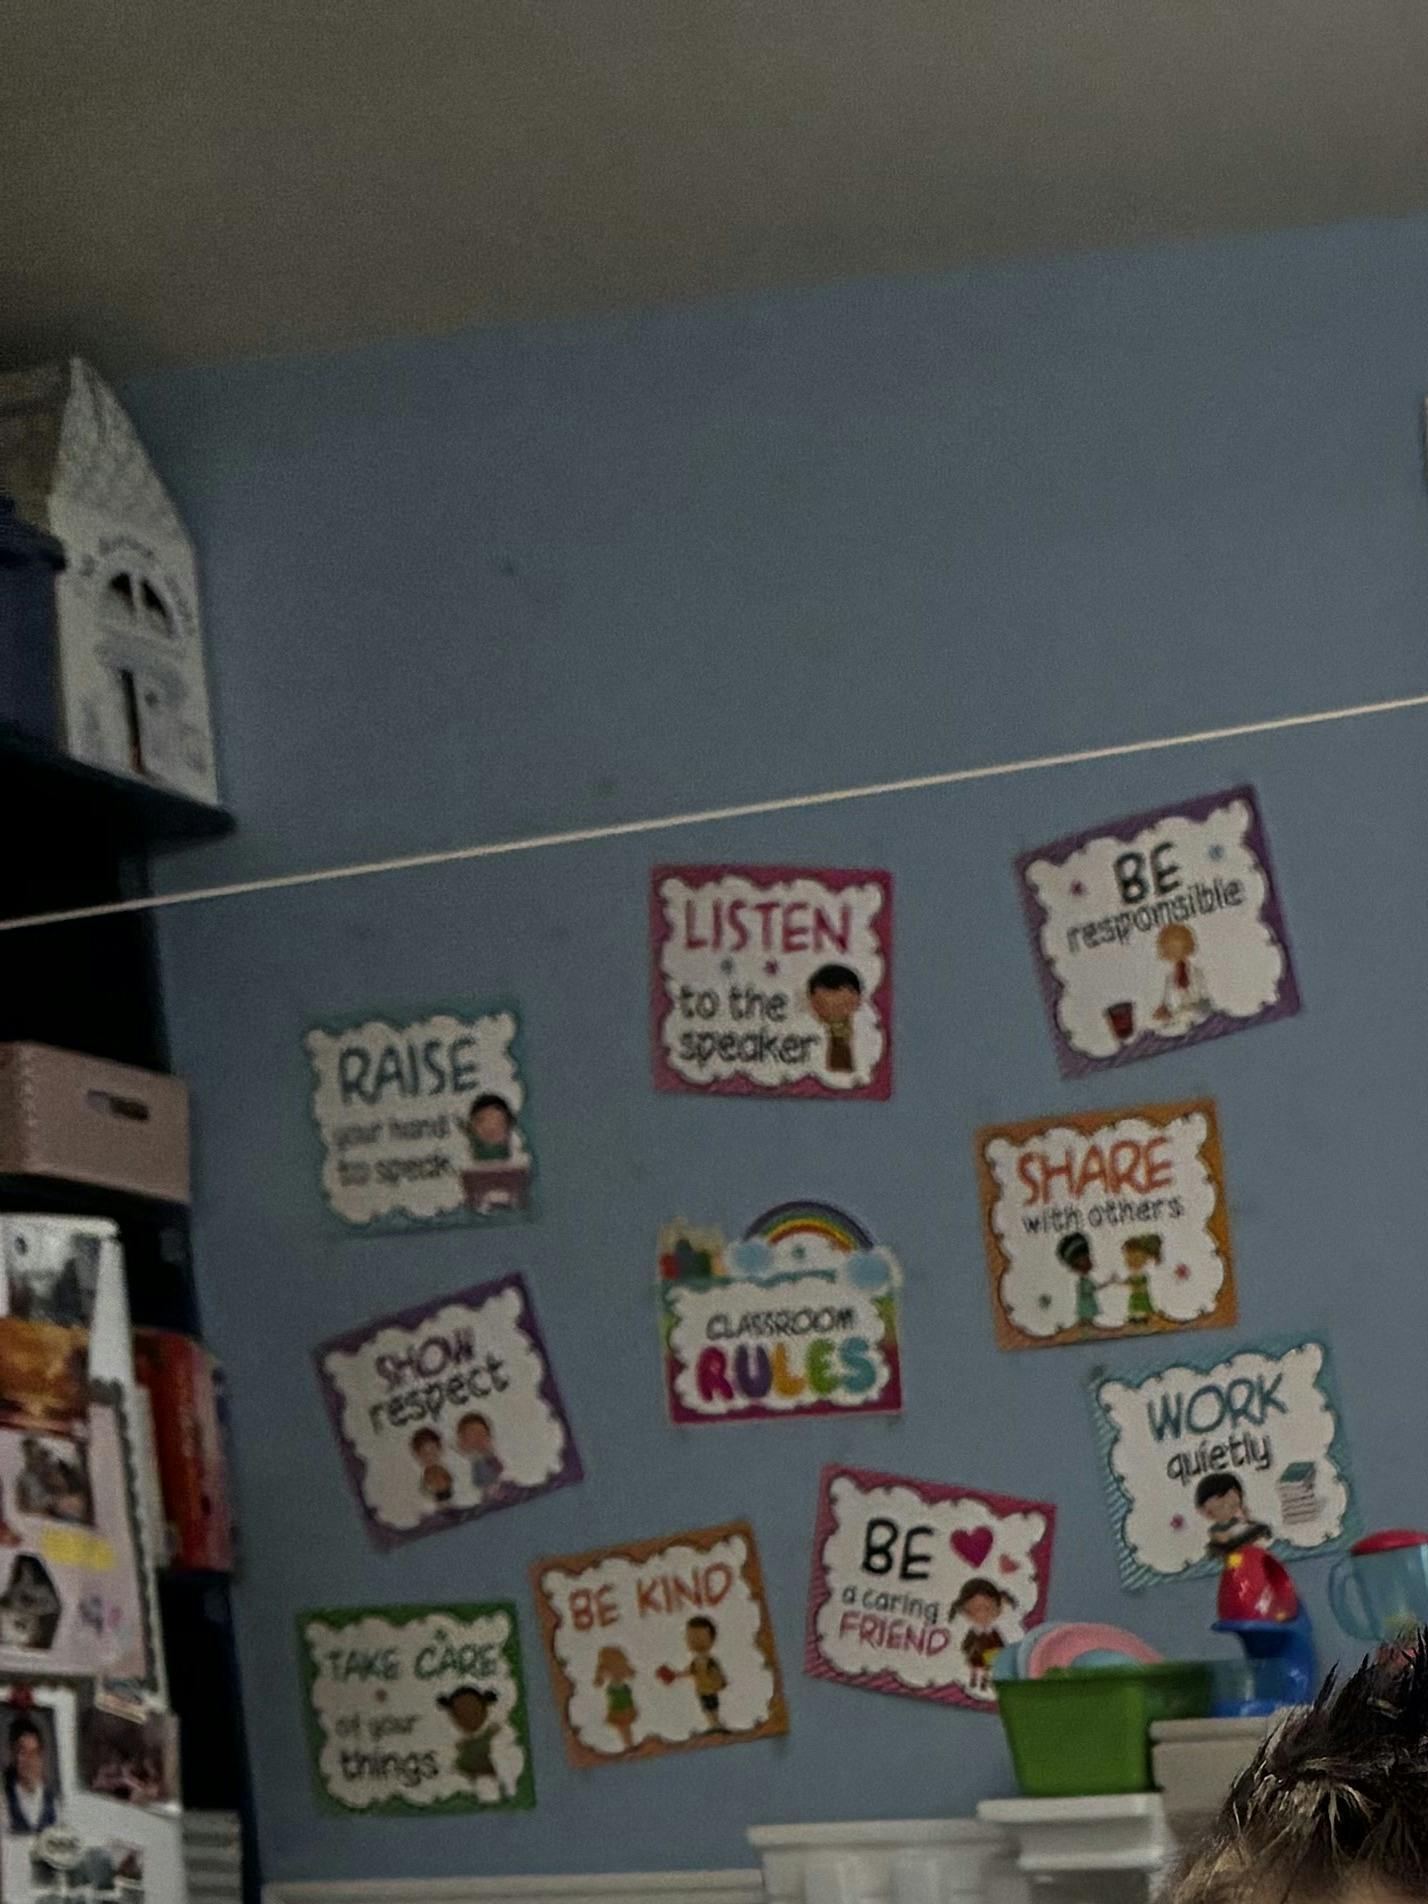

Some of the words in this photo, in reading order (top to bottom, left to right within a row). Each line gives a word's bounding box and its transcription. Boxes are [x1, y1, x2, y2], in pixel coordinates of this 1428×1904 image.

[1112, 841, 1186, 903] BE
[684, 901, 853, 954] LISTEN
[1067, 876, 1245, 954] responsible
[680, 987, 718, 1019] to
[729, 984, 787, 1022] the
[338, 1035, 480, 1105] RAISE
[679, 1029, 819, 1069] speaker
[1017, 1136, 1174, 1206] SHARE
[1022, 1200, 1080, 1236] with
[1086, 1194, 1184, 1233] others
[706, 1306, 855, 1341] CLASSROOM
[367, 1352, 510, 1435] respect
[696, 1336, 877, 1405] RULES
[1146, 1371, 1289, 1442] WORK
[1166, 1431, 1275, 1486] quietly
[862, 1517, 934, 1581] BE
[571, 1584, 620, 1632] BE
[635, 1562, 734, 1617] KIND
[842, 1588, 858, 1608] a
[861, 1585, 941, 1624] caring
[839, 1610, 952, 1657] FRIEND
[329, 1650, 400, 1682] TAKE
[414, 1642, 499, 1681] CARE
[340, 1750, 439, 1789] things
